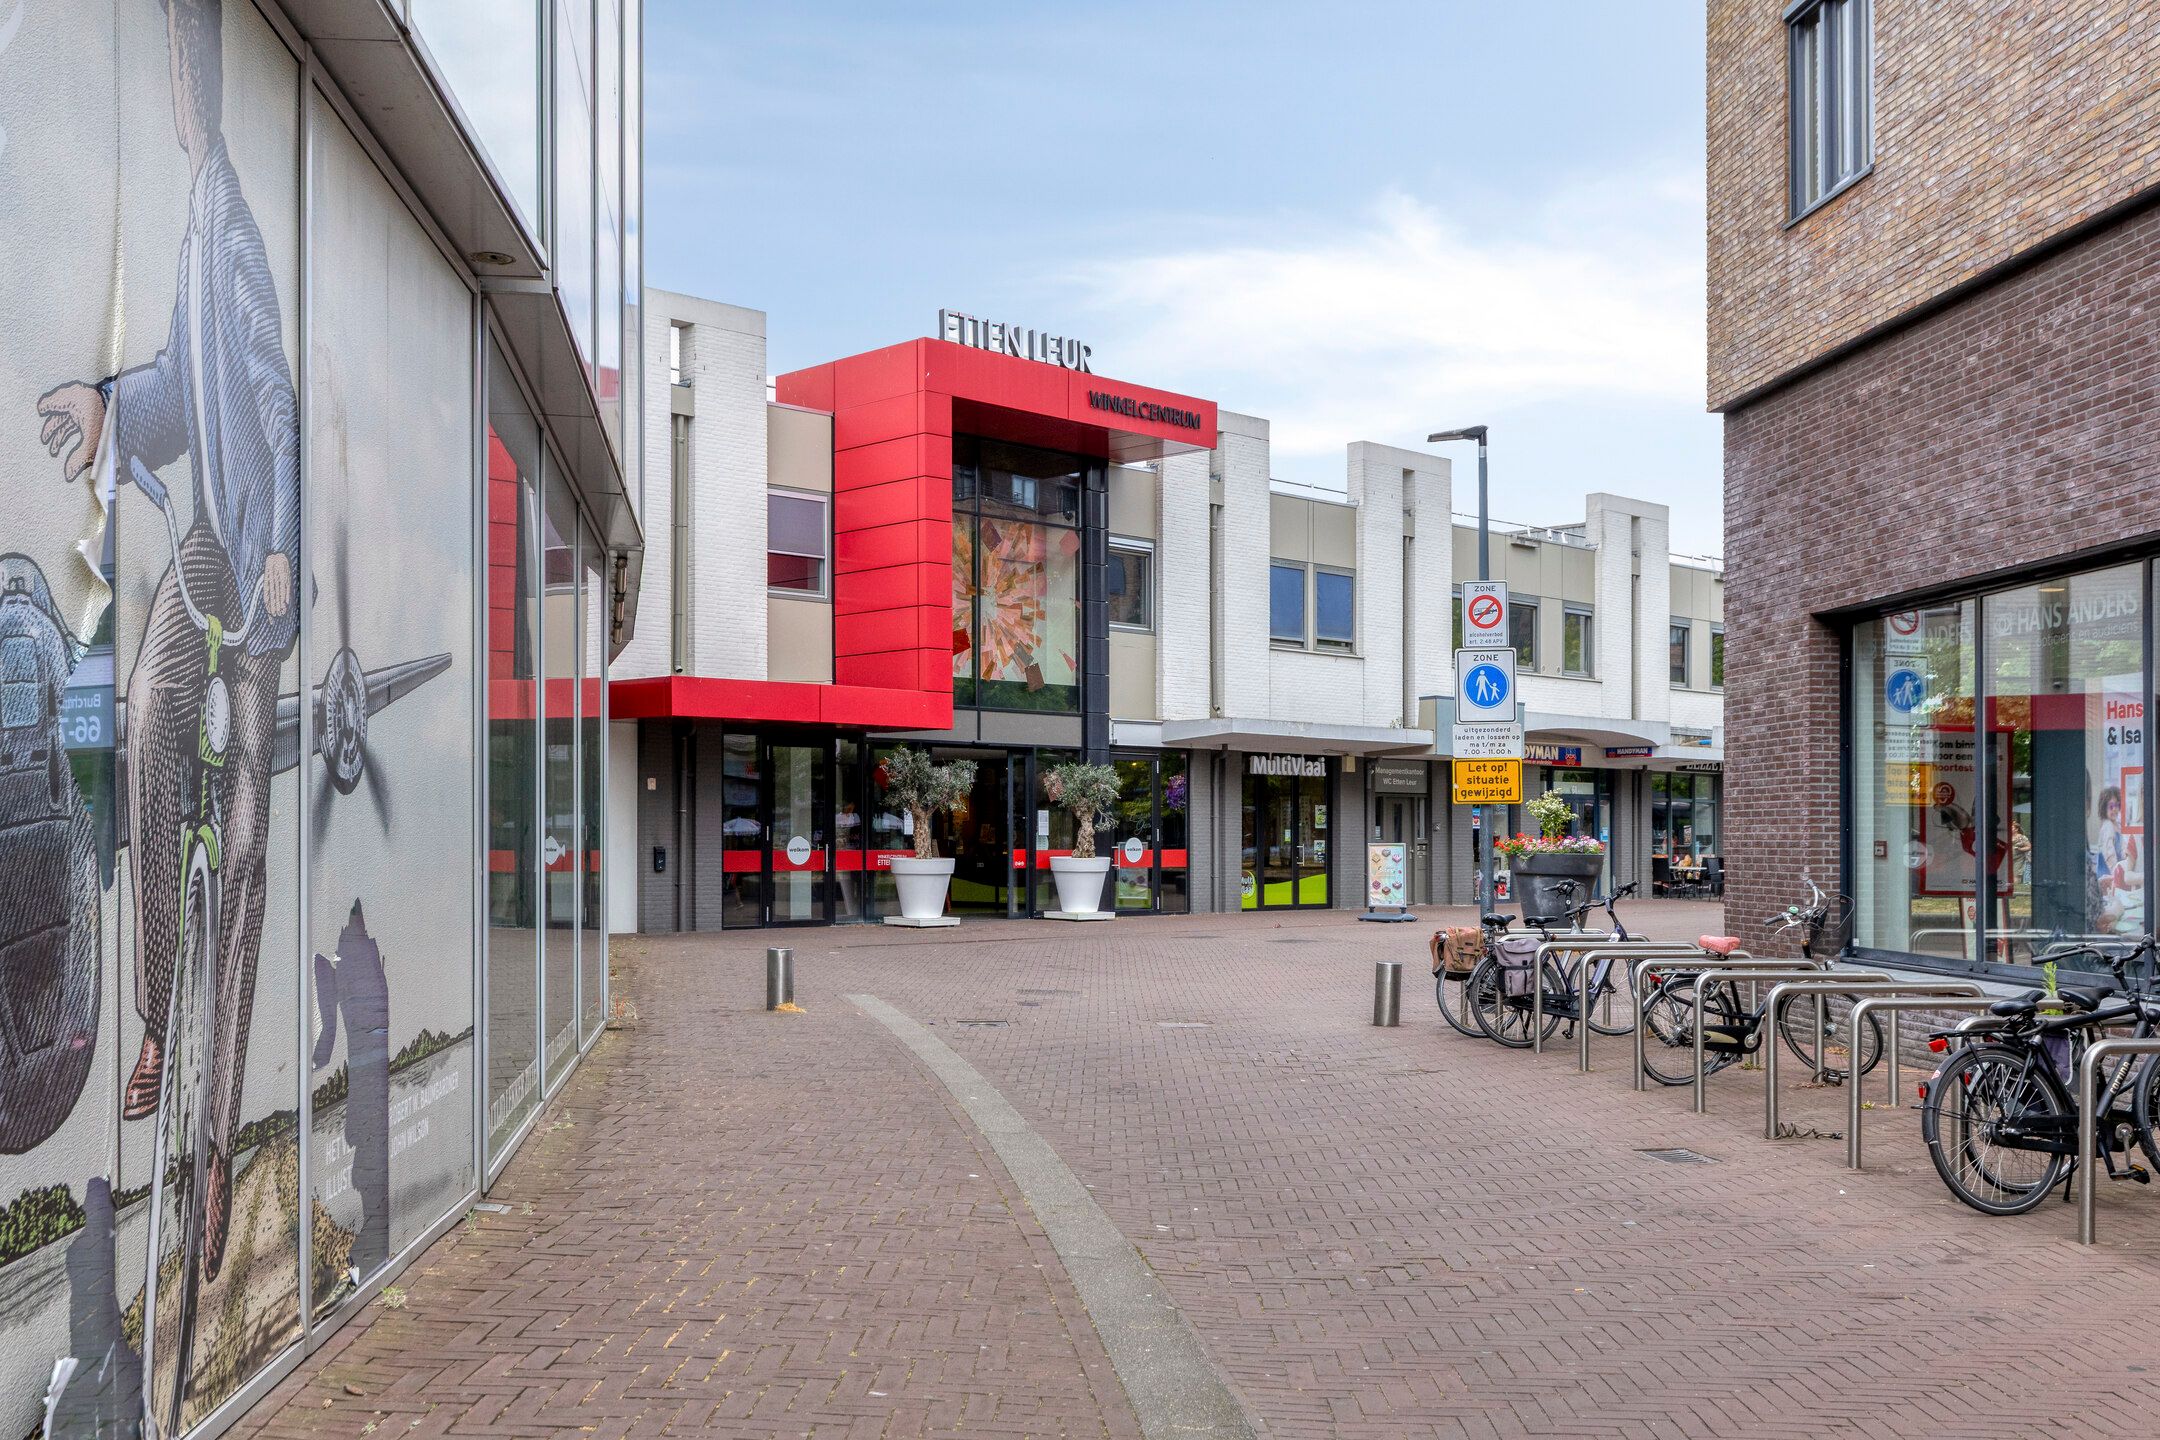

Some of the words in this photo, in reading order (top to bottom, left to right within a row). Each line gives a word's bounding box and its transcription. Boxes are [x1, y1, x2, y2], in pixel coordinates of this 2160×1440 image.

[939, 308, 1030, 360] ETTEN
[1028, 328, 1093, 374] LEUR
[1088, 389, 1201, 430] WINKELCENTRUM
[2017, 602, 2062, 634] HANS
[2067, 590, 2139, 625] ANDERS
[2078, 629, 2090, 640] en
[1473, 654, 1499, 662] ZONE
[2106, 700, 2144, 720] Hans
[1464, 726, 1511, 734] uitgezonderd
[2107, 726, 2118, 745] &
[2121, 725, 2142, 745] Isa
[1616, 747, 1649, 755] HANDYMAN
[1250, 755, 1327, 777] MultiVlaai
[1375, 766, 1425, 775] Managementkantoor
[1468, 763, 1487, 773] Let
[1490, 763, 1508, 773] op!
[1932, 763, 1975, 773] hoortest
[1466, 775, 1509, 785] situatie
[1460, 787, 1512, 799] gewijzigd
